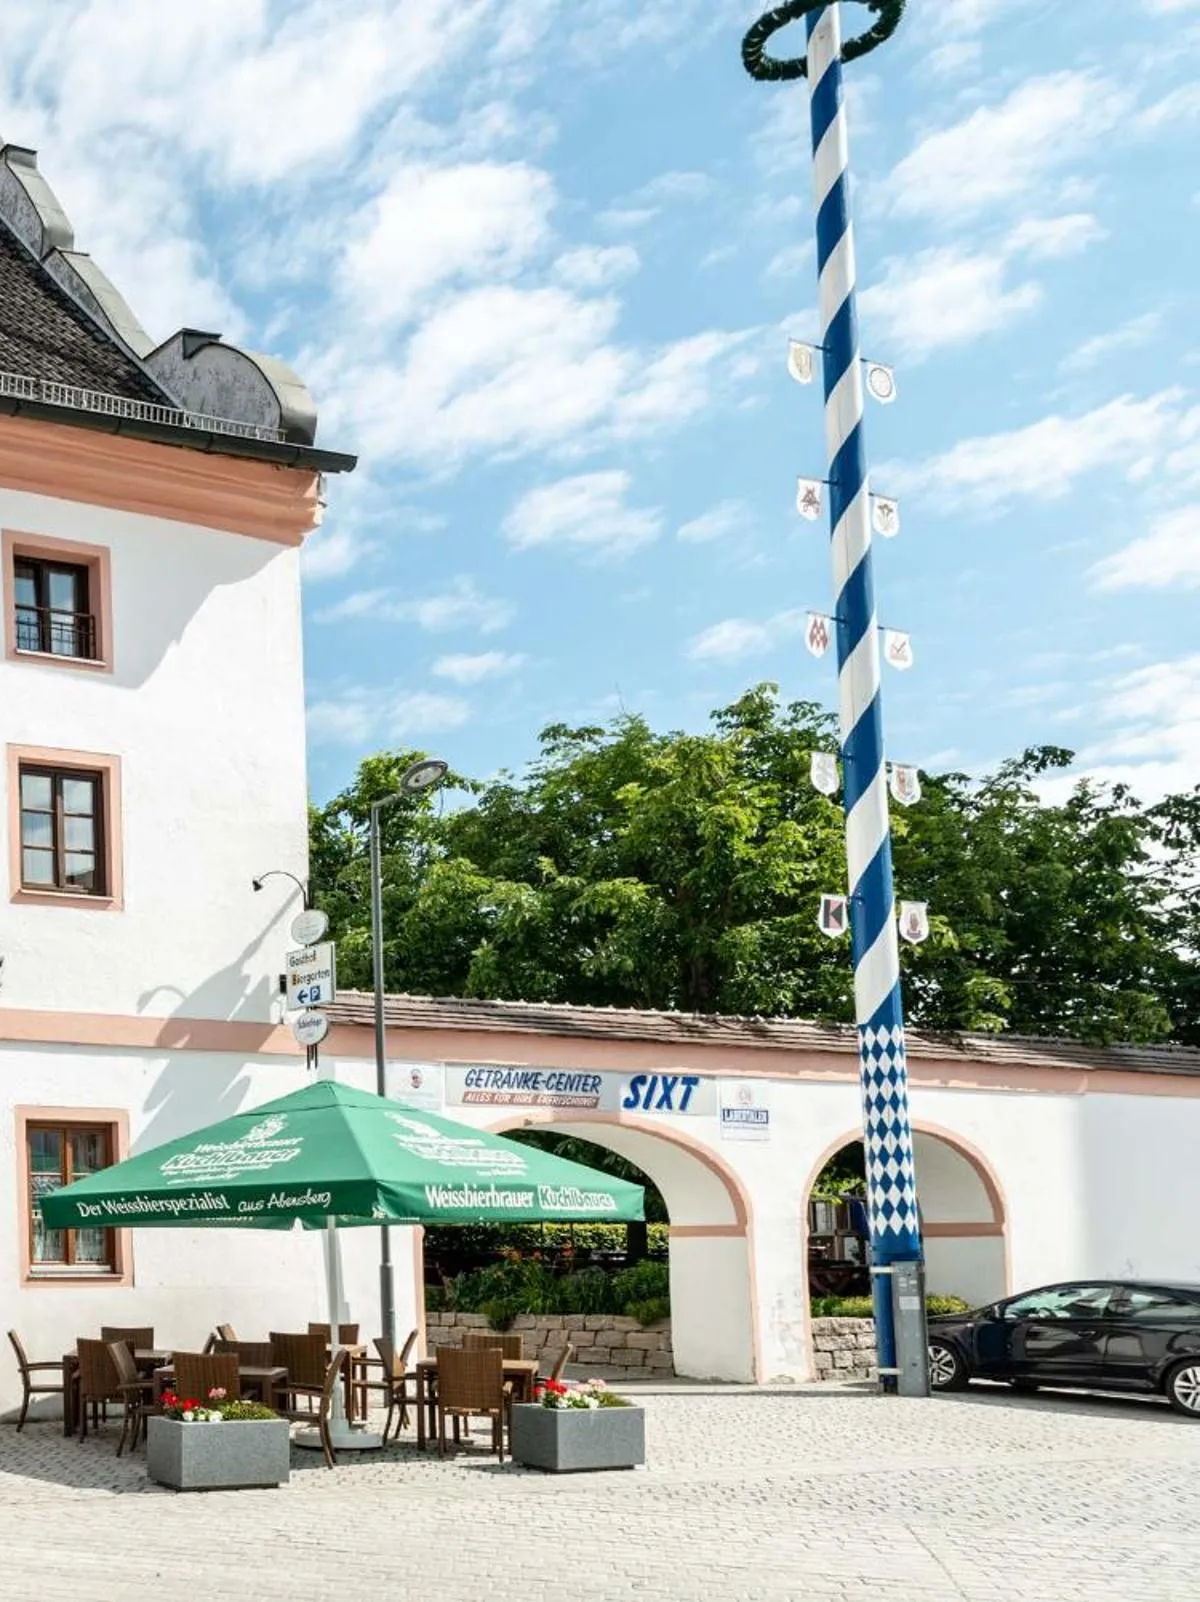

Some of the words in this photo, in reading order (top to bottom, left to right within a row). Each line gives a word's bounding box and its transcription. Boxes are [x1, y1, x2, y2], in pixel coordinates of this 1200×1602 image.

[464, 1068, 602, 1093] GETRÄNKE-CENTER
[622, 1074, 700, 1112] SIXT
[76, 1201, 102, 1218] Der
[101, 1192, 231, 1216] Weissbierspezialist
[238, 1200, 265, 1213] aus
[267, 1188, 332, 1208] Abensberg
[425, 1182, 534, 1209] Weissbierbrauer
